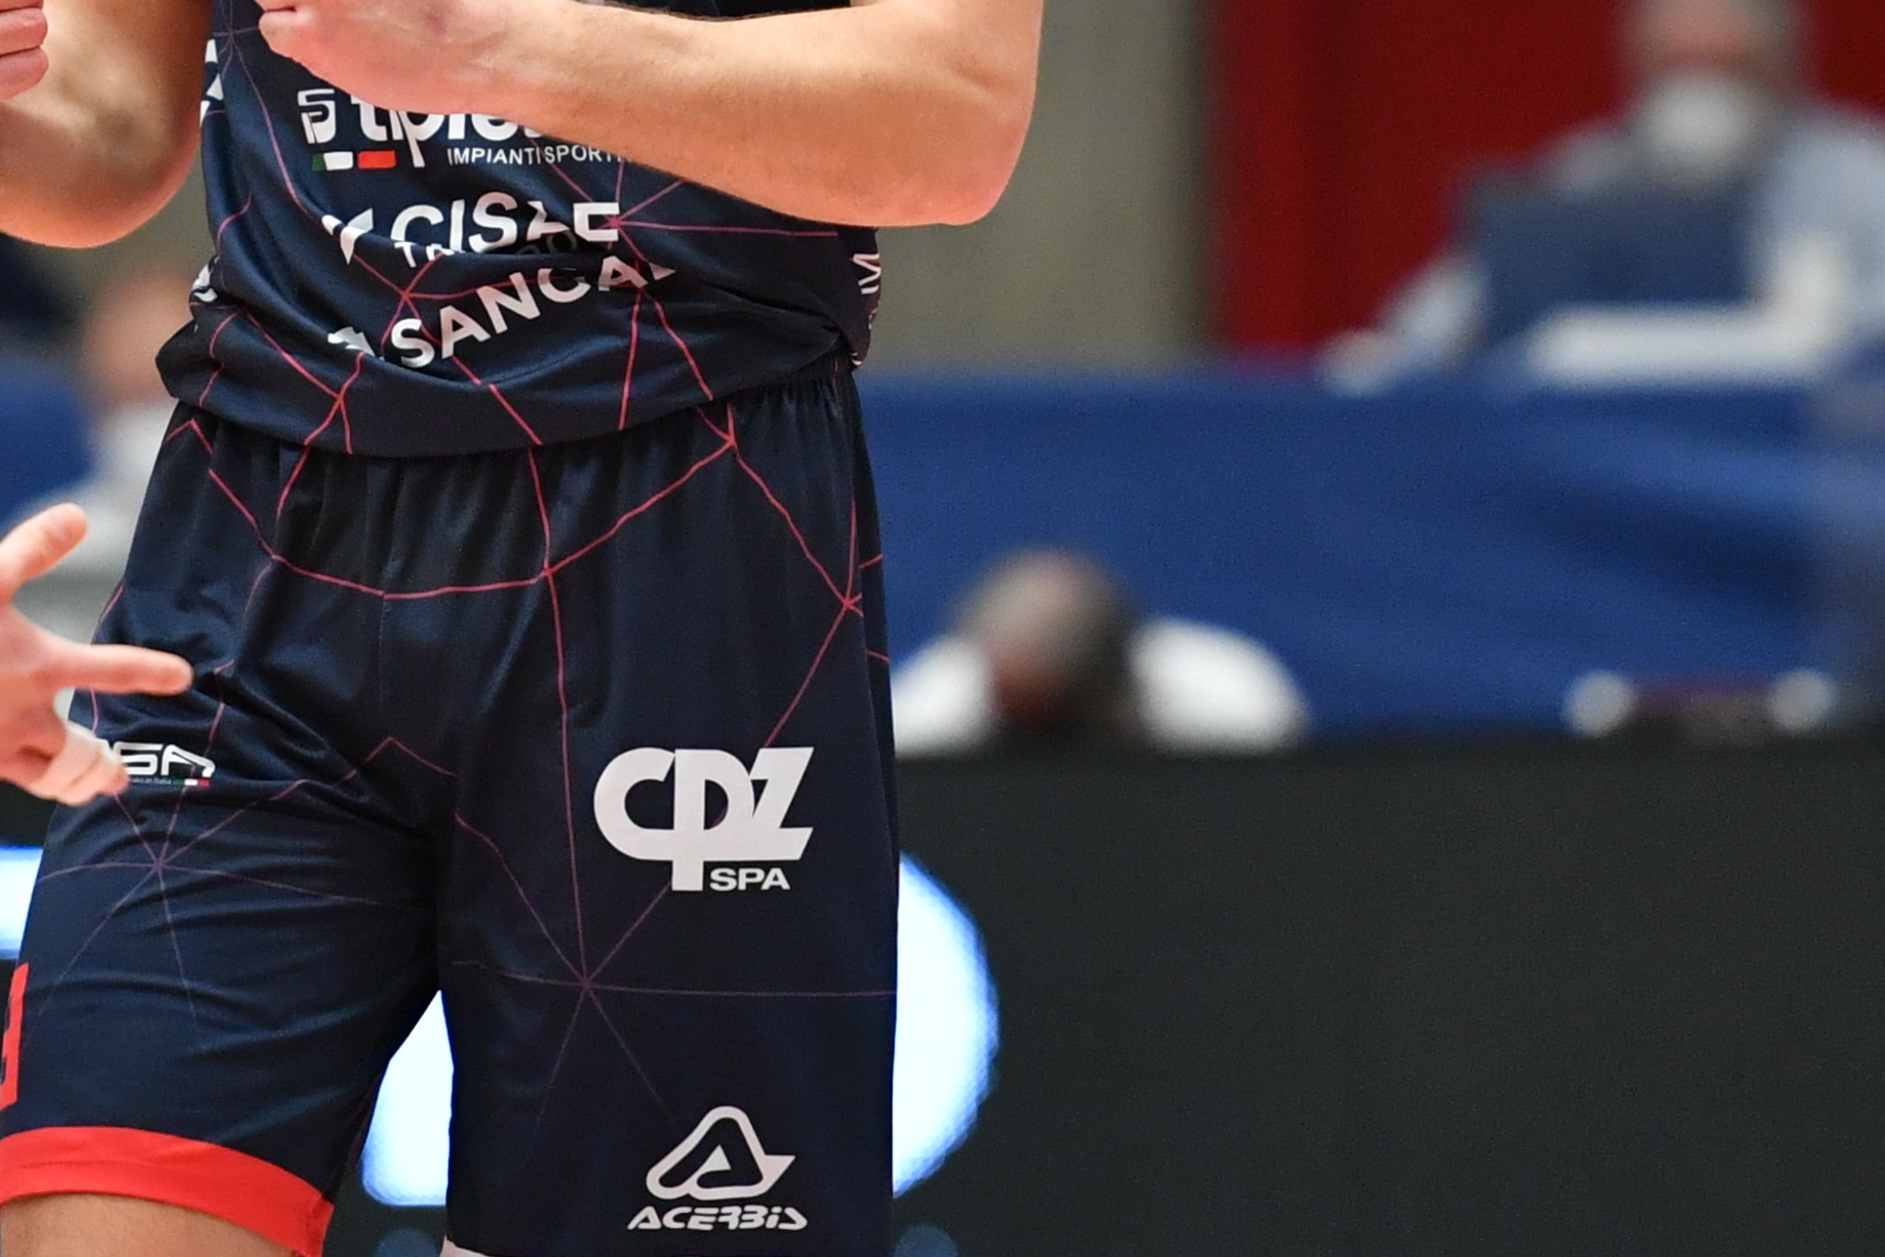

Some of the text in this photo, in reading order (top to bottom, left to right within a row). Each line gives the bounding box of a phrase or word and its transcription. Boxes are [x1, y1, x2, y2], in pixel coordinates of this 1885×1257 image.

[447, 147, 542, 166] IMPIANTI
[709, 867, 792, 892] SPA
[626, 1204, 809, 1232] ACERBIS
